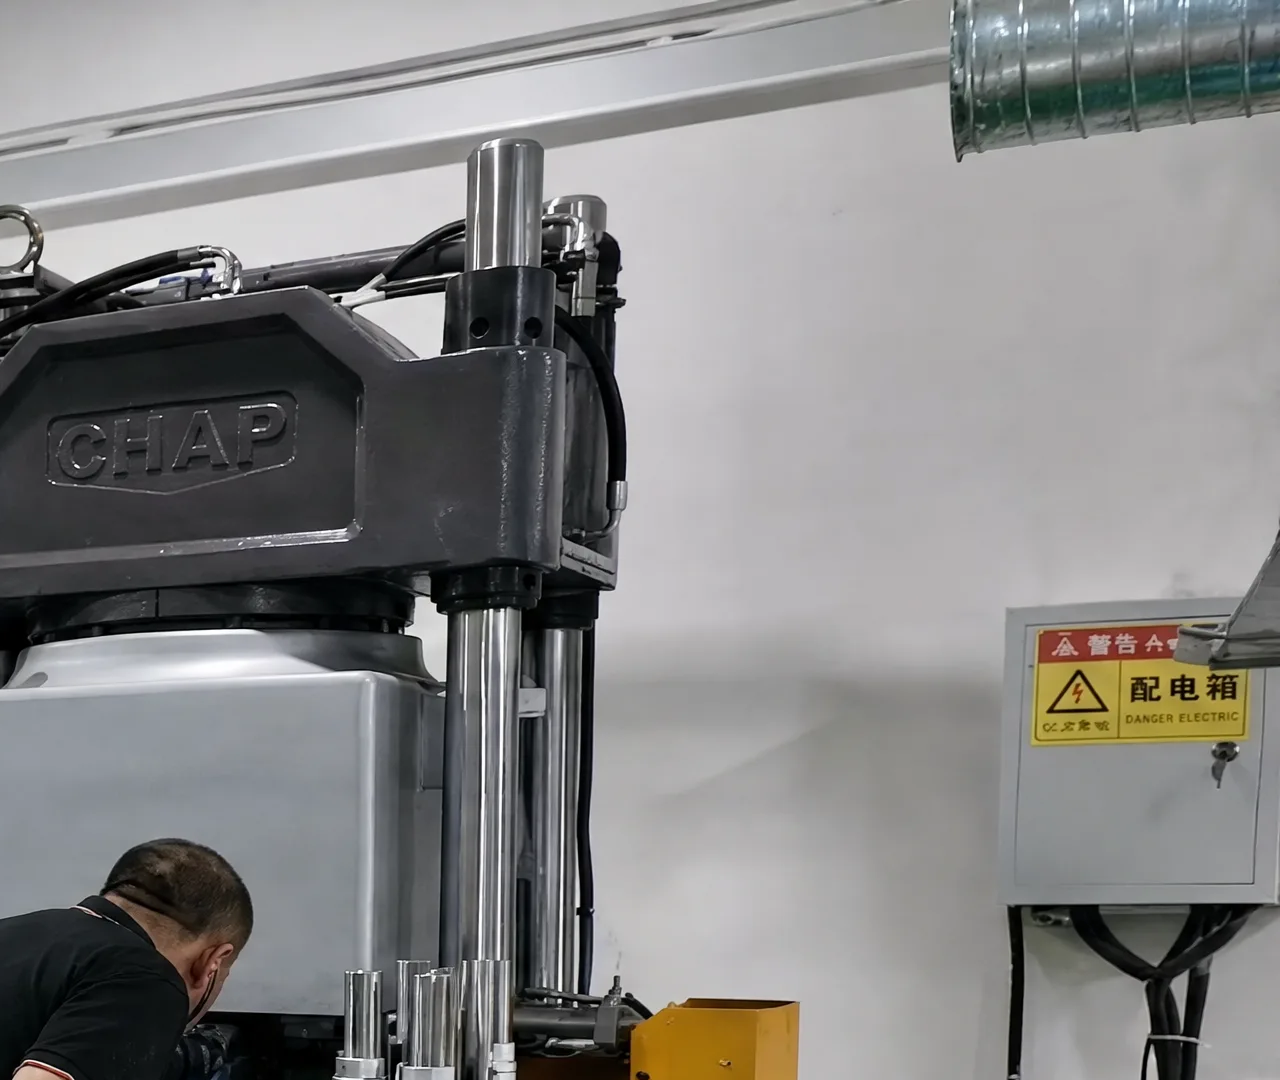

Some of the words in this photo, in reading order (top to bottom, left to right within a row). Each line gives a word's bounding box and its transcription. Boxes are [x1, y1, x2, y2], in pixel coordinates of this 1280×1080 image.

[56, 402, 288, 480] CHAP
[1130, 673, 1239, 702] 配电箱
[1125, 714, 1173, 724] DANGER
[1178, 712, 1239, 723] ELECTRIC
